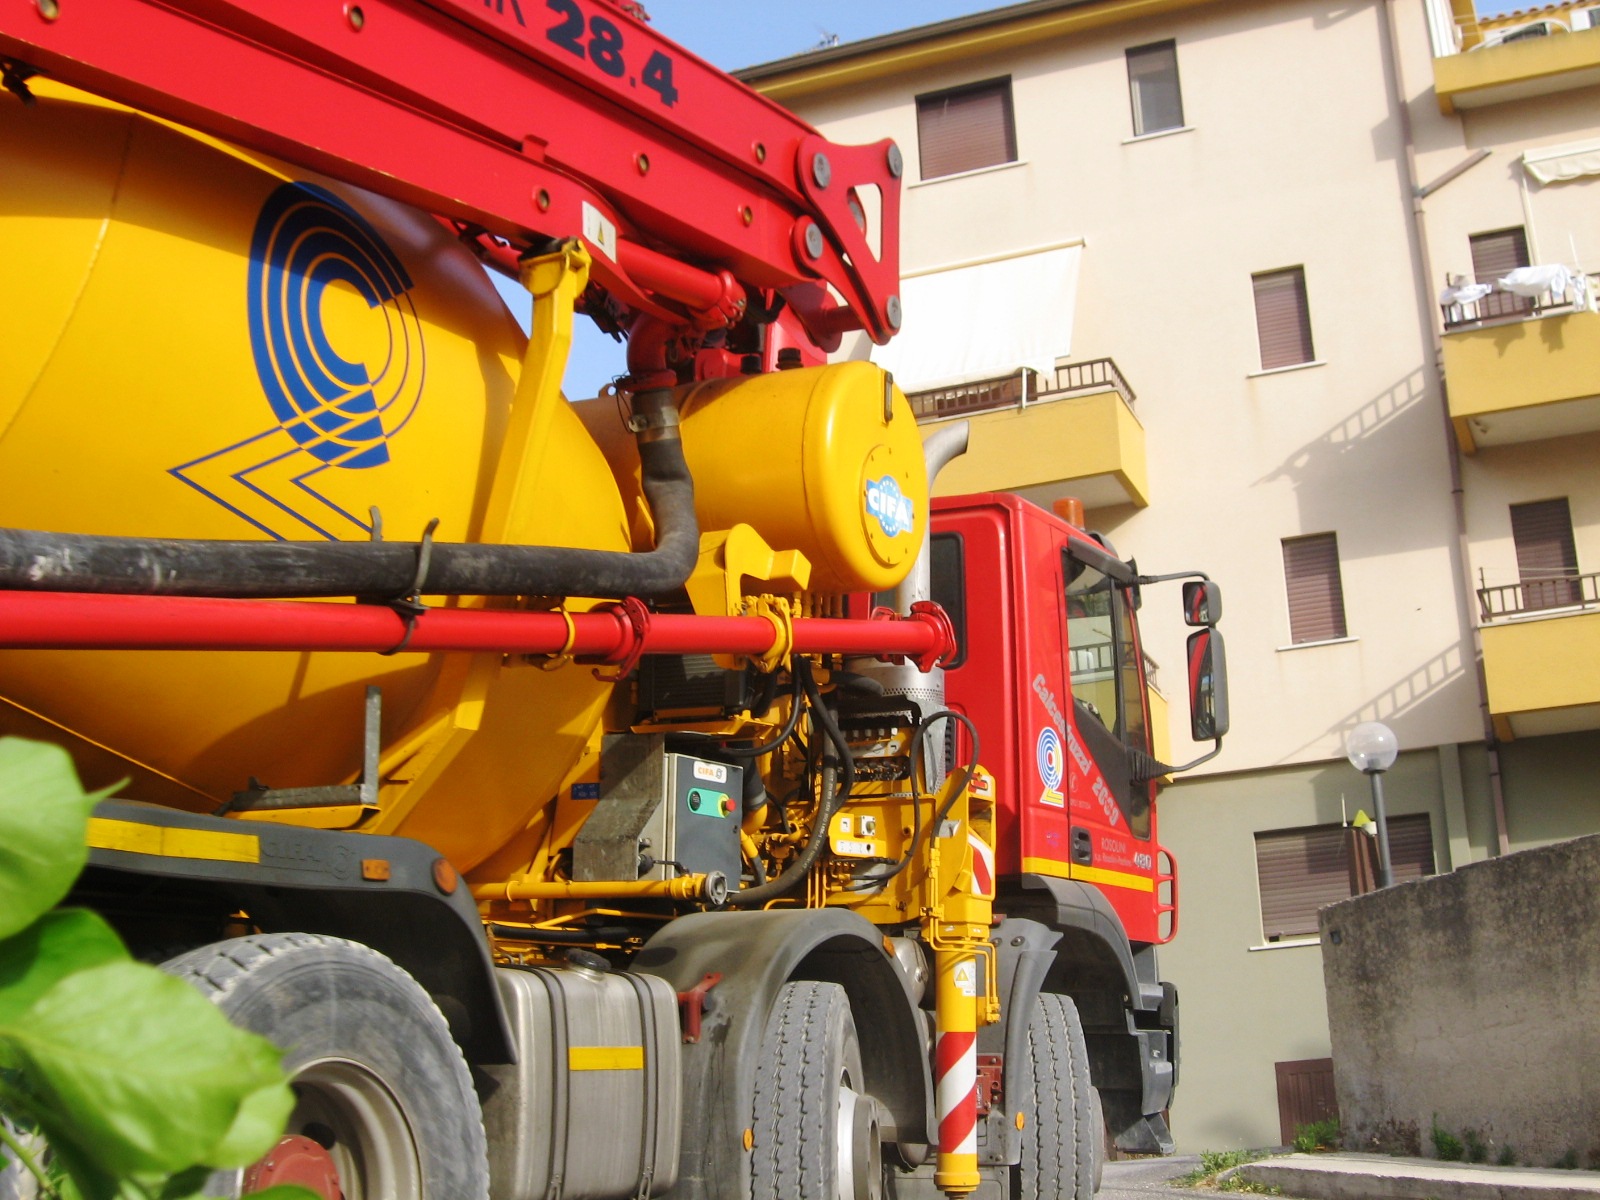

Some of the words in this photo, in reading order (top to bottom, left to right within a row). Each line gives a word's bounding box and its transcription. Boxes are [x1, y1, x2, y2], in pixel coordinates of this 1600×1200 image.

[545, 0, 679, 108] 28.4
[867, 487, 909, 525] CIFA
[1032, 673, 1093, 777] Calcestruzzi
[697, 766, 715, 777] CIFA
